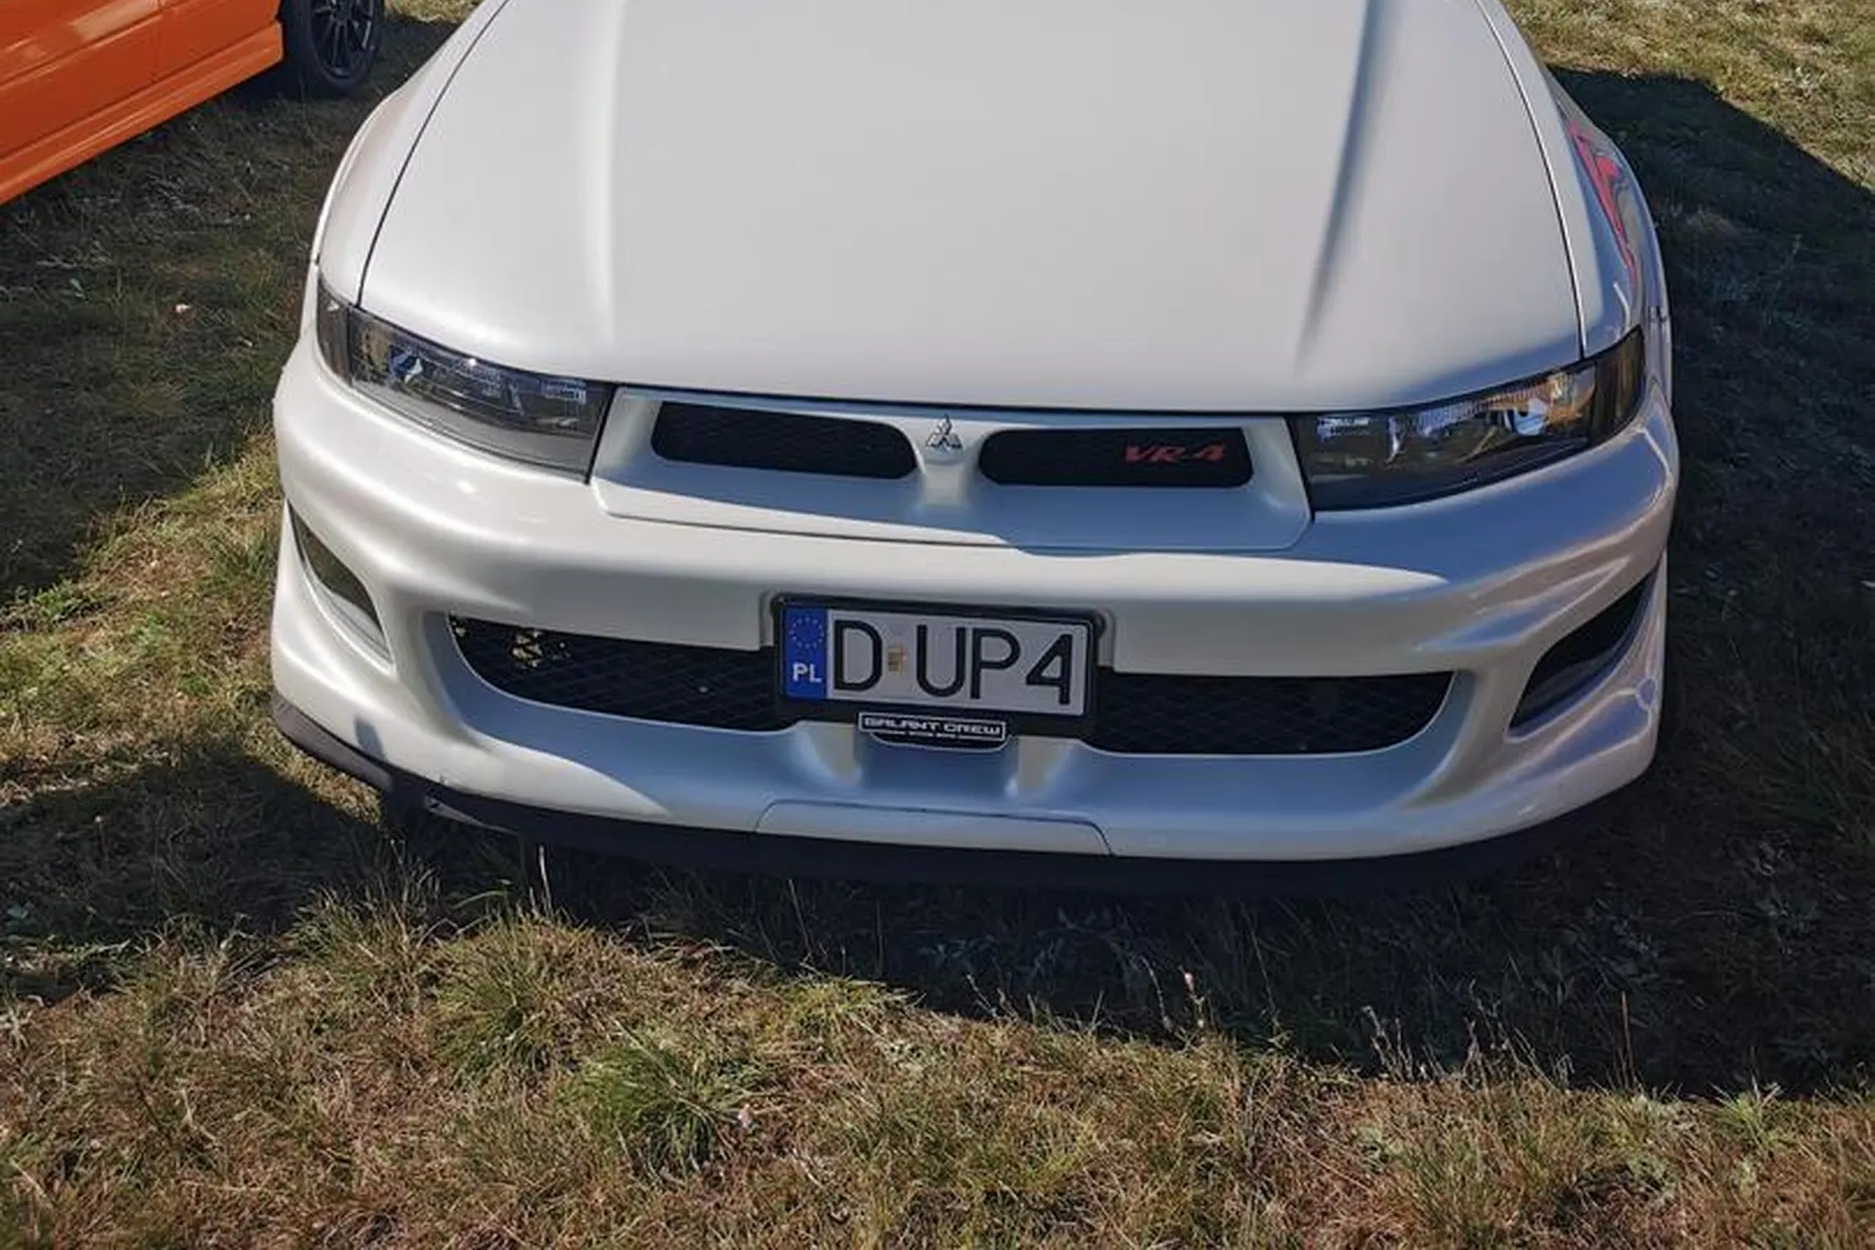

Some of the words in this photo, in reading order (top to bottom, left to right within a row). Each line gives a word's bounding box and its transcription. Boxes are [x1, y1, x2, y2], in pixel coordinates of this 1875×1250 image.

[792, 662, 823, 684] PL
[833, 619, 883, 691] D
[915, 623, 1074, 706] UP4
[864, 716, 939, 731] GALANT
[944, 724, 1000, 735] CREW
